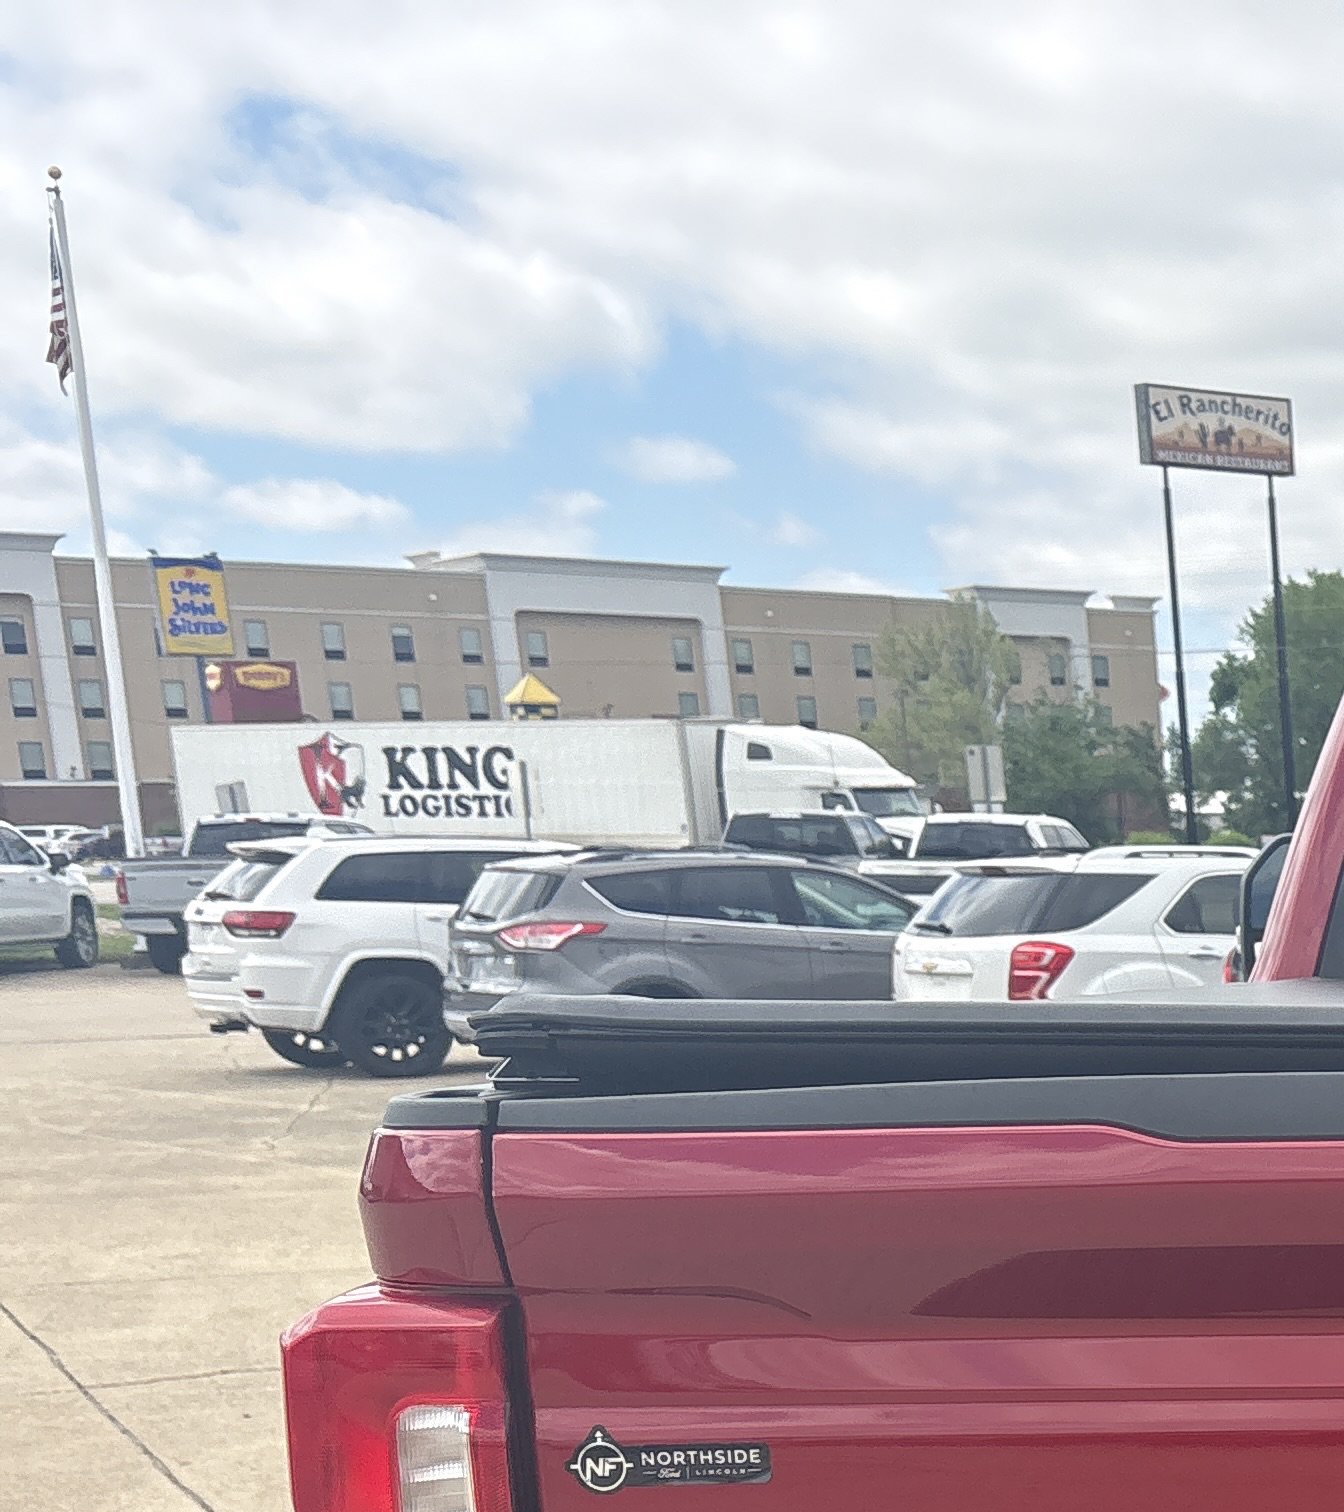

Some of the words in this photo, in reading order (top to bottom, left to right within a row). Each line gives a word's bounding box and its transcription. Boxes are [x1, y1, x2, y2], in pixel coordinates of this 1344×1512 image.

[1150, 398, 1174, 422] El
[1178, 394, 1290, 436] Rancherito
[381, 745, 514, 791] KING
[640, 1448, 762, 1467] NORTHSIDE
[585, 1457, 624, 1482] NF
[657, 1467, 682, 1480] Ford
[694, 1468, 746, 1477] LINCOLN
